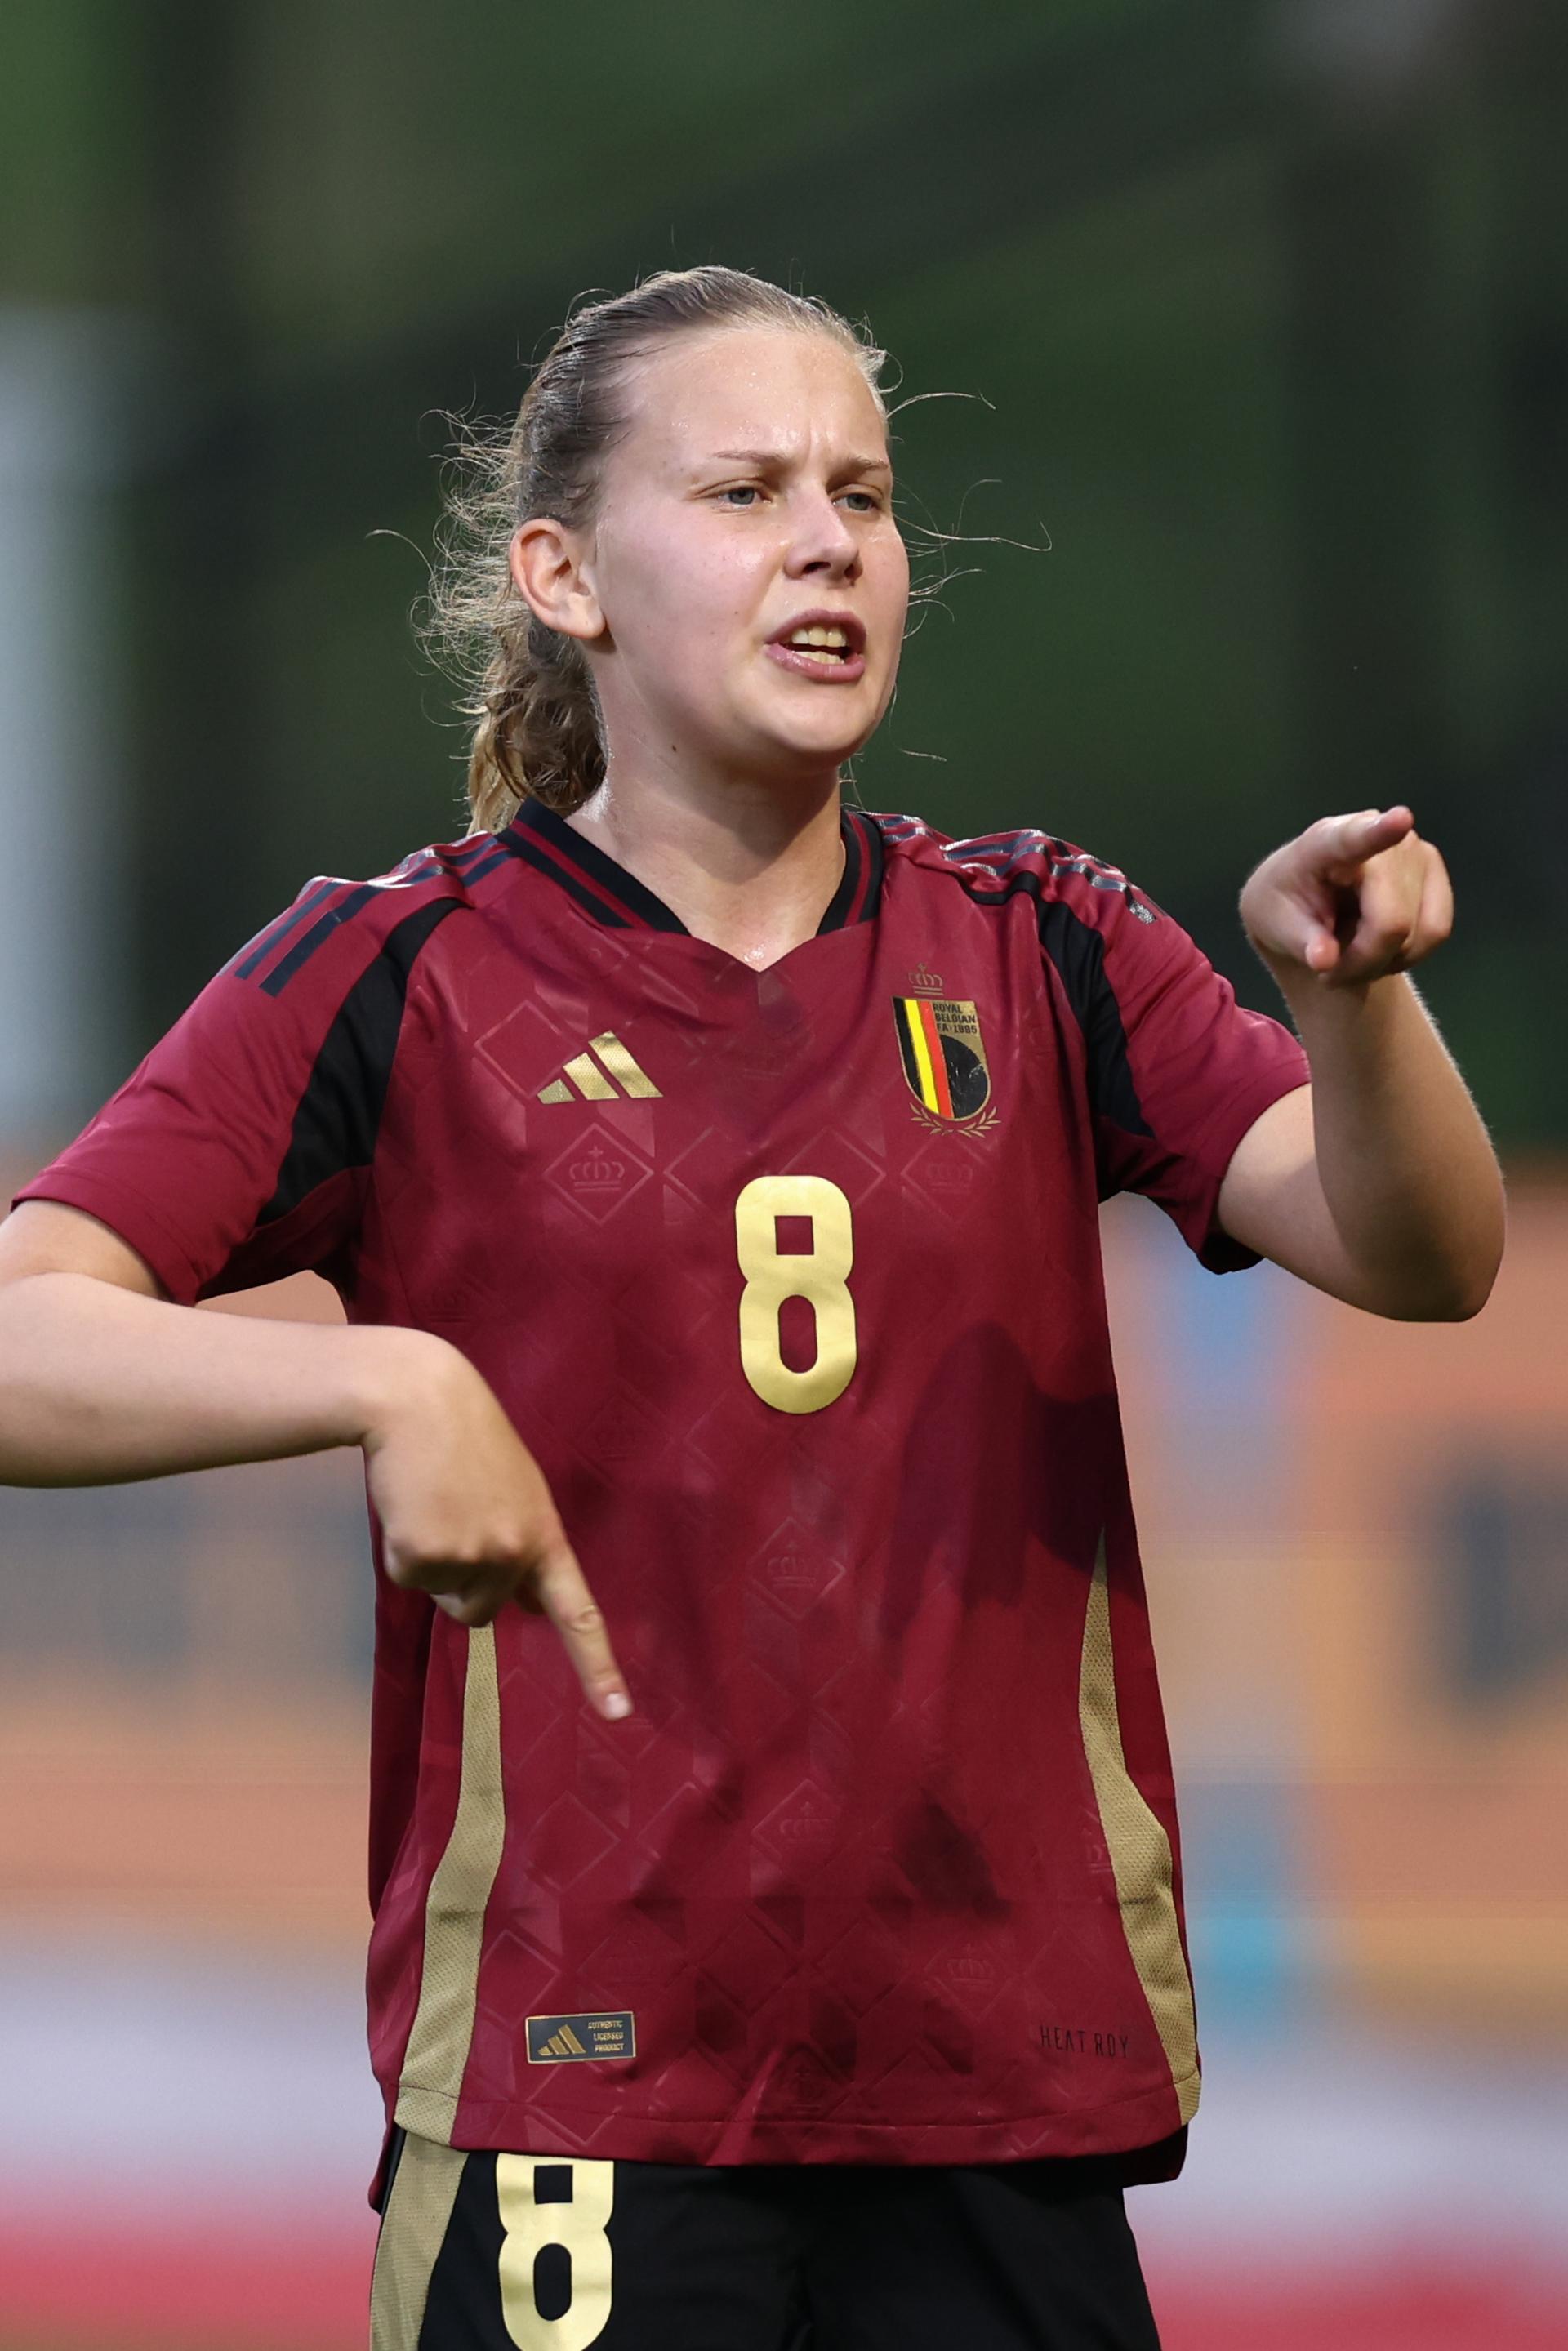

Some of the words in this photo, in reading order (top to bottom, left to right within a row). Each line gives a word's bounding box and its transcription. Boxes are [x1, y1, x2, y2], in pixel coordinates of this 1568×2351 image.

[932, 1003, 963, 1013] ROYAL
[735, 1175, 857, 1414] 8
[1040, 2025, 1085, 2052] HEAT
[496, 2153, 614, 2351] 8
